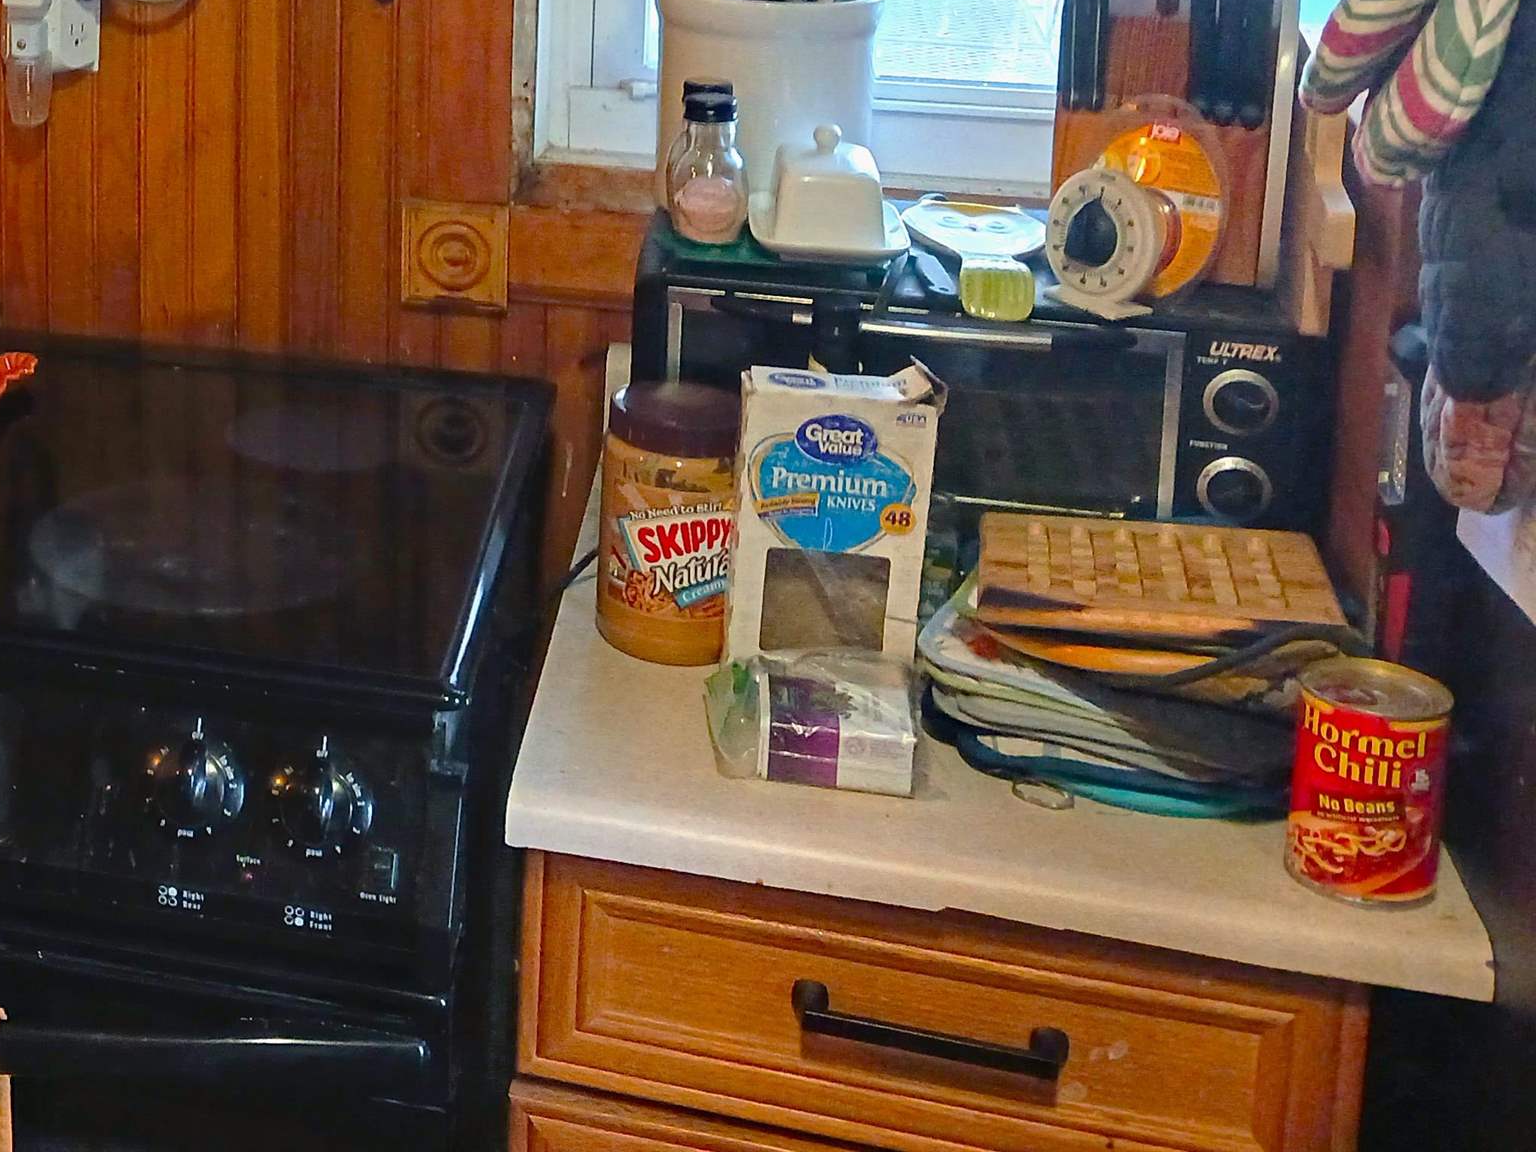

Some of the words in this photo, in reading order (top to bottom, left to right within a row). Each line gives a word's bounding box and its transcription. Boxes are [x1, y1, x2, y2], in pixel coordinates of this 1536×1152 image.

[1210, 341, 1278, 362] ULTREX
[805, 423, 864, 447] Great
[818, 440, 863, 457] Value
[772, 466, 888, 497] Premium
[630, 510, 646, 521] No
[647, 505, 680, 519] Need
[681, 503, 694, 514] to
[827, 494, 876, 512] KNIVES
[885, 511, 911, 528] 48
[637, 517, 732, 564] SKIPPY
[1303, 703, 1428, 759] Hormel
[1313, 741, 1402, 789] Chili
[1318, 793, 1340, 811] No
[1343, 798, 1396, 815] Beans
[182, 889, 205, 903] Right
[309, 910, 332, 922] Right
